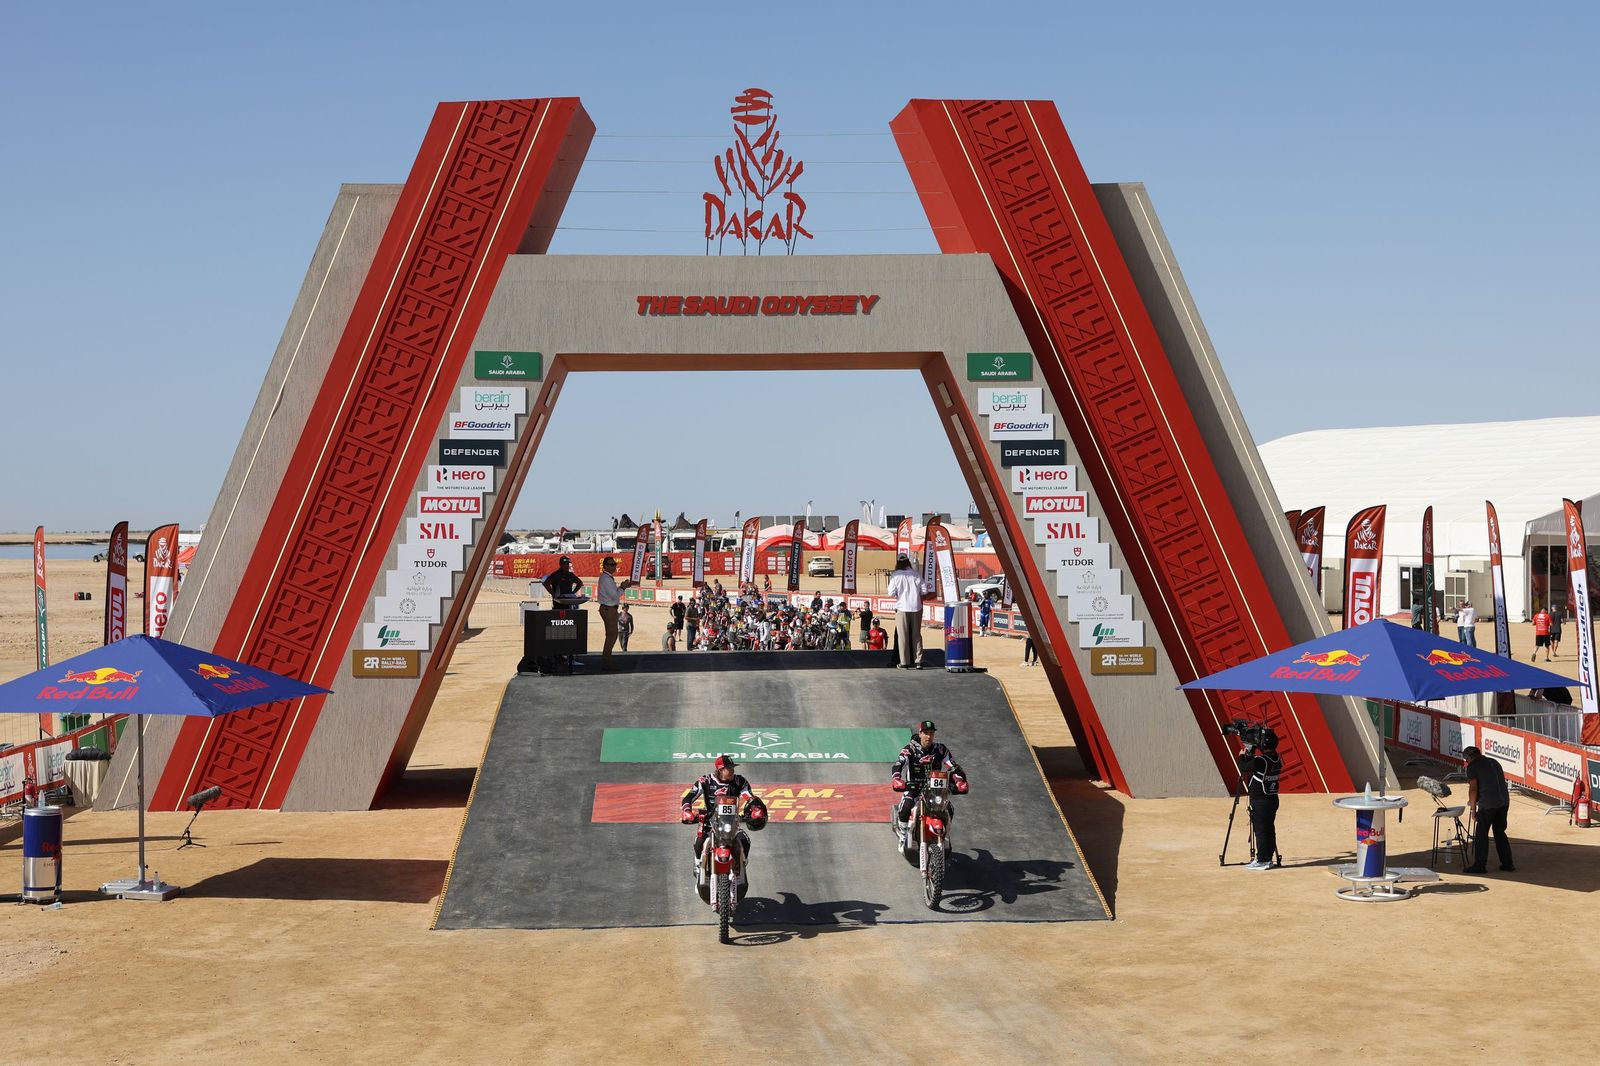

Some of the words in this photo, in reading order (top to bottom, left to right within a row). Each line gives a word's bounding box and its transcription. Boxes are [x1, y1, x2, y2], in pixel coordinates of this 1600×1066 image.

[703, 192, 813, 240] DAKAR
[637, 295, 684, 315] THE
[682, 295, 760, 315] SAUDI
[761, 295, 879, 315] ODYSSEY
[453, 421, 511, 430] BFGoodrich
[993, 422, 1049, 430] BFGoodrich
[443, 448, 500, 456] DEFENDER
[423, 499, 478, 511] MOTUL
[1028, 498, 1082, 511] MOTUL
[1354, 540, 1378, 550] DAKAR
[414, 560, 448, 568] TUDOR
[635, 550, 643, 574] TUDOR
[791, 543, 800, 584] DEFENDER
[1354, 576, 1372, 625] OTUL
[112, 590, 123, 639] OTUL
[1269, 666, 1314, 680] Red
[1311, 669, 1363, 682] Bull
[1435, 668, 1474, 682] Red
[1467, 665, 1509, 680] Bull
[37, 686, 90, 700] Red
[87, 686, 140, 700] Bull
[1485, 738, 1520, 759] BFGoodrich
[1539, 754, 1578, 779] BFGoodrich
[934, 779, 943, 787] 84
[722, 805, 732, 814] 85
[784, 810, 833, 820] IT.
[1370, 828, 1385, 837] Bull
